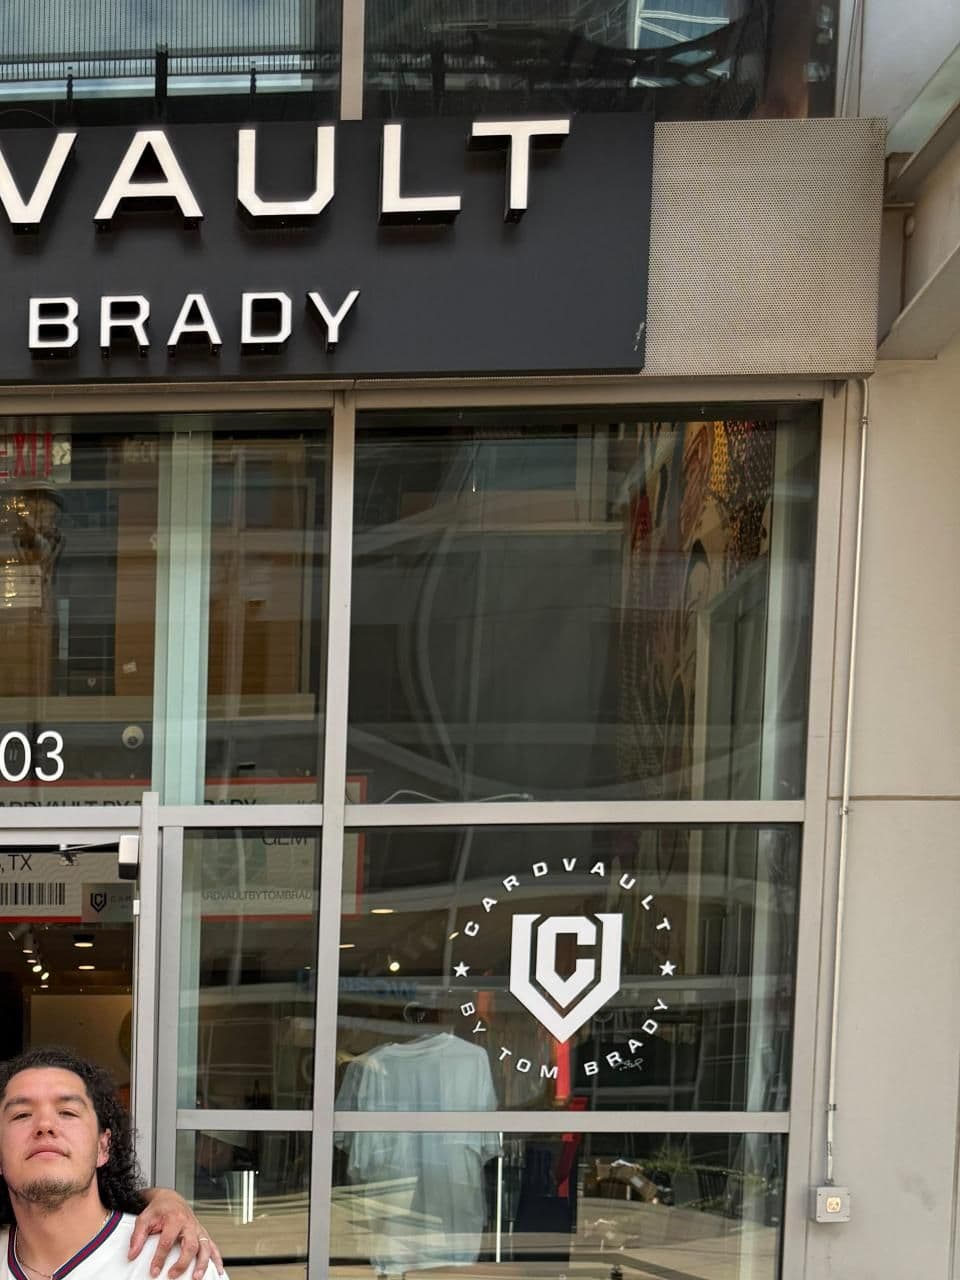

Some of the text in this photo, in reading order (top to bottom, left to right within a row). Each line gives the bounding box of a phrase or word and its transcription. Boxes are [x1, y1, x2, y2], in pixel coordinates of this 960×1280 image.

[29, 290, 360, 349] BRADY
[9, 854, 33, 871] TX
[463, 857, 672, 937] CARDVAULT
[460, 998, 670, 1080] BY TOM BRADY
